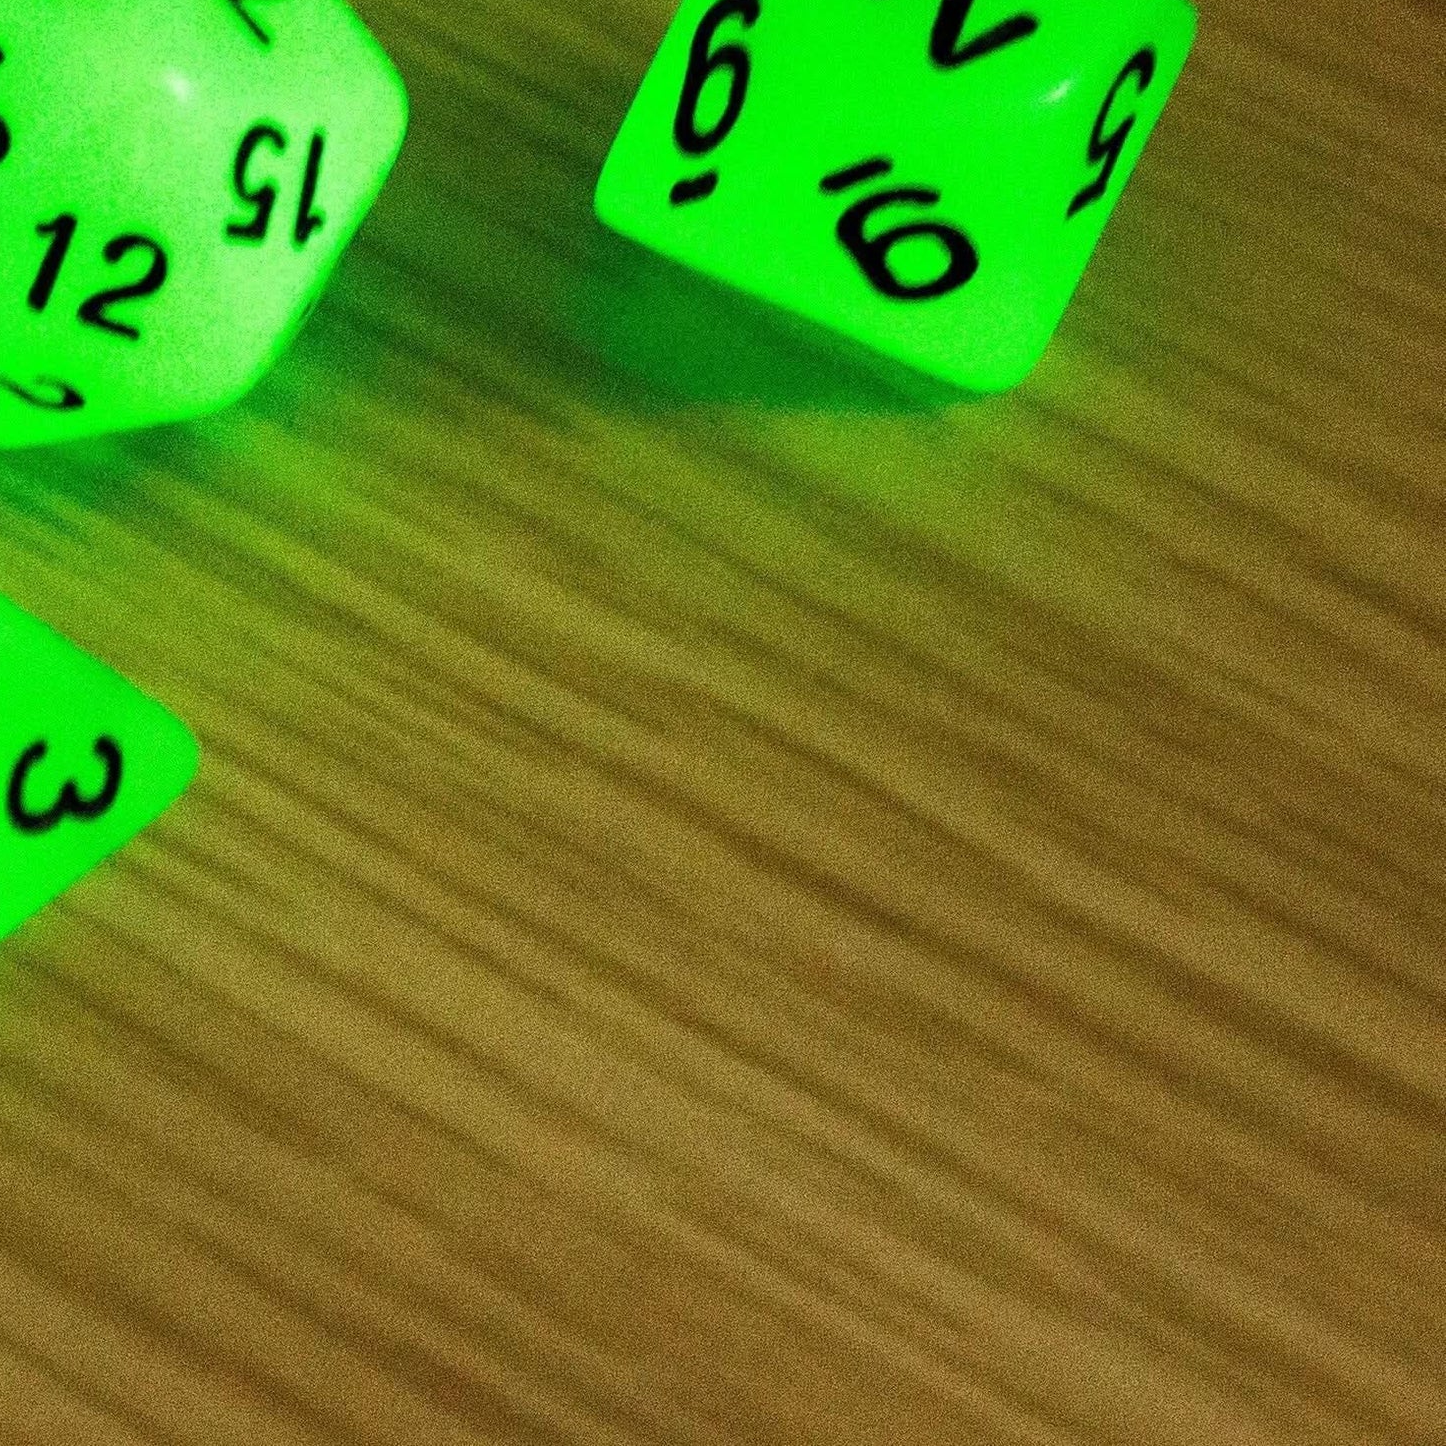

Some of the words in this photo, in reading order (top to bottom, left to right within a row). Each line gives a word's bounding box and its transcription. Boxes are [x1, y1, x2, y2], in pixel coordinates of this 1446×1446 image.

[222, 116, 326, 250] 15
[26, 211, 169, 343] 12
[4, 734, 126, 837] 3
